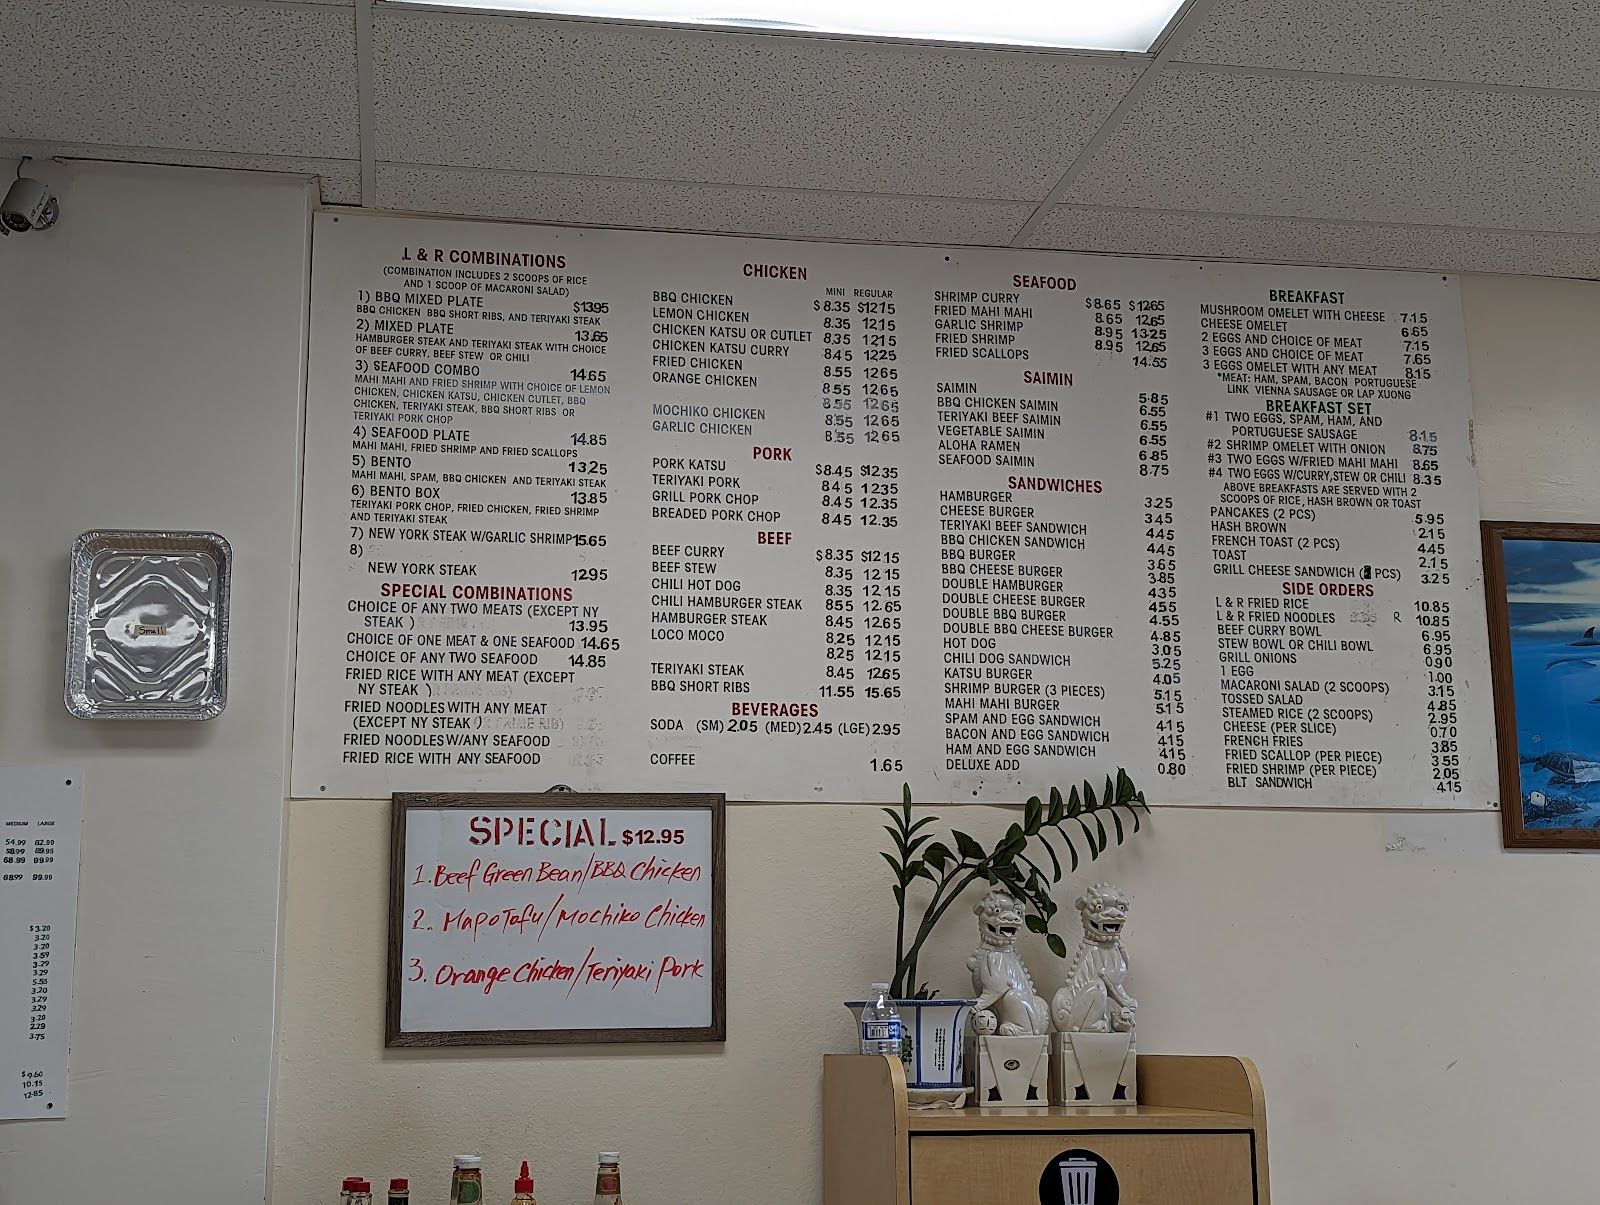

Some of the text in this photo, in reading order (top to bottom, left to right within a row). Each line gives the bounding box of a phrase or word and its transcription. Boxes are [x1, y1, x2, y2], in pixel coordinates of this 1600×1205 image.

[405, 247, 565, 268] L & R COMBINATIONS
[744, 264, 806, 280] CHICKEN
[1013, 275, 1076, 290] SEAFOOD
[359, 290, 483, 307] 1) BBQ MIXED PLATE
[654, 291, 732, 305] BBQ CHICKEN
[826, 288, 892, 298] MINI REGULAR
[935, 291, 1019, 303] SHRIMP CURRY
[1270, 290, 1344, 304] BREAKFAST
[653, 307, 850, 329] LEMON CHICKEN 8.35
[1201, 304, 1263, 317] MUSHROOM
[1268, 308, 1309, 318] OMELET
[1313, 309, 1340, 320] WITH
[1345, 311, 1385, 321] CHEESE
[357, 319, 369, 332] 2)
[375, 320, 412, 332] MIXED
[418, 322, 453, 334] PLATE
[653, 323, 812, 341] CHICKEN KATSU OR CUTLET
[356, 346, 367, 354] OF
[371, 347, 392, 355] BEEF
[434, 350, 455, 358] BEEF
[459, 351, 483, 360] STEW
[506, 353, 529, 361] CHILI
[356, 360, 368, 373] 3)
[374, 361, 429, 373] SEAFOOD
[435, 364, 479, 376] COMBO
[653, 372, 756, 387] ORANGE CHICKEN
[1024, 371, 1072, 386] SAIMIN
[1266, 400, 1371, 415] BREAKFAST SET
[353, 426, 606, 445] 4) SEAFOOD PLATE 14.85
[938, 420, 1167, 439] VEGETABLE SAIMIN 6.55
[939, 440, 1019, 452] ALOHA RAMEN
[353, 455, 411, 468] 5) BENTO
[754, 447, 792, 461] PORK
[653, 458, 725, 470] PORK KATSU
[352, 485, 440, 498] 6) BENTO BOX
[1009, 476, 1102, 493] SANDWICHES
[940, 491, 1012, 502] HAMBURGER
[758, 532, 791, 544] BEEF
[653, 545, 724, 557] BEEF CURRY
[1212, 550, 1246, 560] TOAST
[368, 562, 476, 575] NEW YORK STEAK
[381, 583, 572, 601] SPECIAL COMBINATIONS
[1283, 582, 1373, 597] SIDE ORDERS
[569, 620, 608, 632] 13.95
[1218, 625, 1450, 641] BEEF CURRY BOWL 6.95
[652, 629, 724, 641] LOCO MOCO
[944, 638, 996, 648] HOT DOG
[347, 650, 605, 667] CHOICE OF ANY TWO SEAFOOD 14.85
[827, 666, 854, 679] 8.45
[945, 668, 1180, 685] KATSU BURGER 4.05
[652, 680, 900, 698] BBQ SHORT RIBS 11.55 15.65
[1221, 693, 1302, 704] TOSSED SALAD
[732, 703, 818, 717] BEVERAGES
[651, 719, 900, 736] SODA (SM) 2.05 (MED) 2.45 (LGE) 2.95
[946, 728, 1109, 742] BACON AND EGG SANDWICH
[1225, 735, 1303, 747] FRENCH FRIES
[651, 754, 902, 771] COFFEE 1.65
[947, 759, 1185, 775] DELUXE ADD 0.80
[1228, 777, 1312, 789] BLT SANDWICH
[469, 816, 685, 848] SPECIAL $12.95
[483, 862, 531, 885] Green
[630, 855, 701, 884] Chicken
[412, 908, 432, 931] 2.
[644, 898, 706, 929] Chicken
[408, 958, 427, 982] 3.
[435, 963, 510, 995] Orange
[655, 956, 704, 994] Pork
